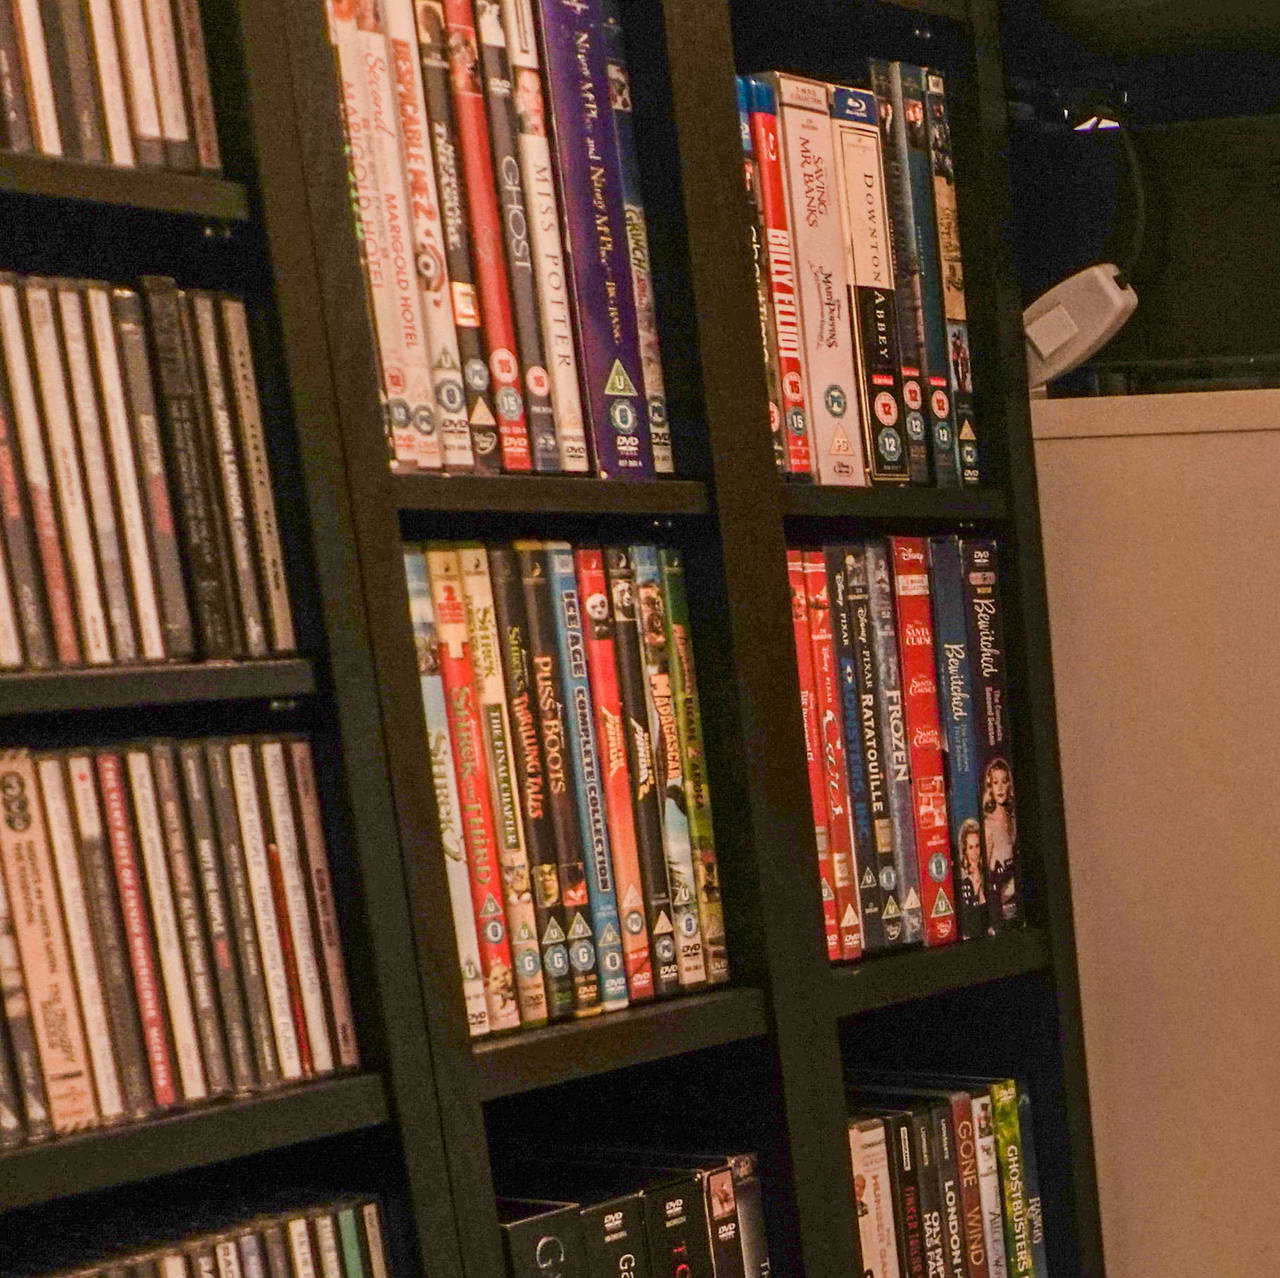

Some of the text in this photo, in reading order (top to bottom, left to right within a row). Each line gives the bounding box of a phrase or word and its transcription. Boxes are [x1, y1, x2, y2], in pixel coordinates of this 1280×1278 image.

[391, 37, 424, 166] DESPICABLE
[413, 200, 437, 222] 2
[501, 155, 533, 268] GHOST
[803, 173, 818, 228] BANKS
[812, 155, 826, 215] SAVING
[384, 192, 418, 348] MARIGOLD HOTEL
[535, 164, 572, 368] MISS POTTER
[624, 203, 647, 272] GRINCH
[863, 173, 890, 359] DOWNTON ABBEY
[766, 228, 801, 358] BILLY ELLIOT
[899, 546, 925, 564] Disney
[839, 613, 850, 646] PIXAR
[858, 606, 874, 688] Disney PIXAR
[905, 626, 930, 637] SANTA
[973, 598, 1000, 678] Bewitched
[534, 655, 567, 794] PUSS BOOTS
[649, 674, 681, 779] MADAGASCAR
[944, 643, 967, 722] Bewitched
[450, 685, 492, 885] SHREK THIRD
[490, 709, 516, 844] THE FINAL CHAPTER
[512, 692, 538, 773] THRILLING
[525, 775, 543, 820] TALES
[561, 590, 611, 892] ICE AGE COMPLETE COLLECTION
[861, 694, 883, 813] RATATOUILLE
[886, 690, 909, 782] FROZEN
[604, 1211, 623, 1223] DVD
[666, 1198, 683, 1210] DVD
[718, 1222, 736, 1234] DVD
[923, 1213, 934, 1248] HAS
[944, 1180, 962, 1265] LONDON
[958, 1120, 985, 1266] GONE WIND
[1007, 1144, 1028, 1272] GHOSTBUSTERS
